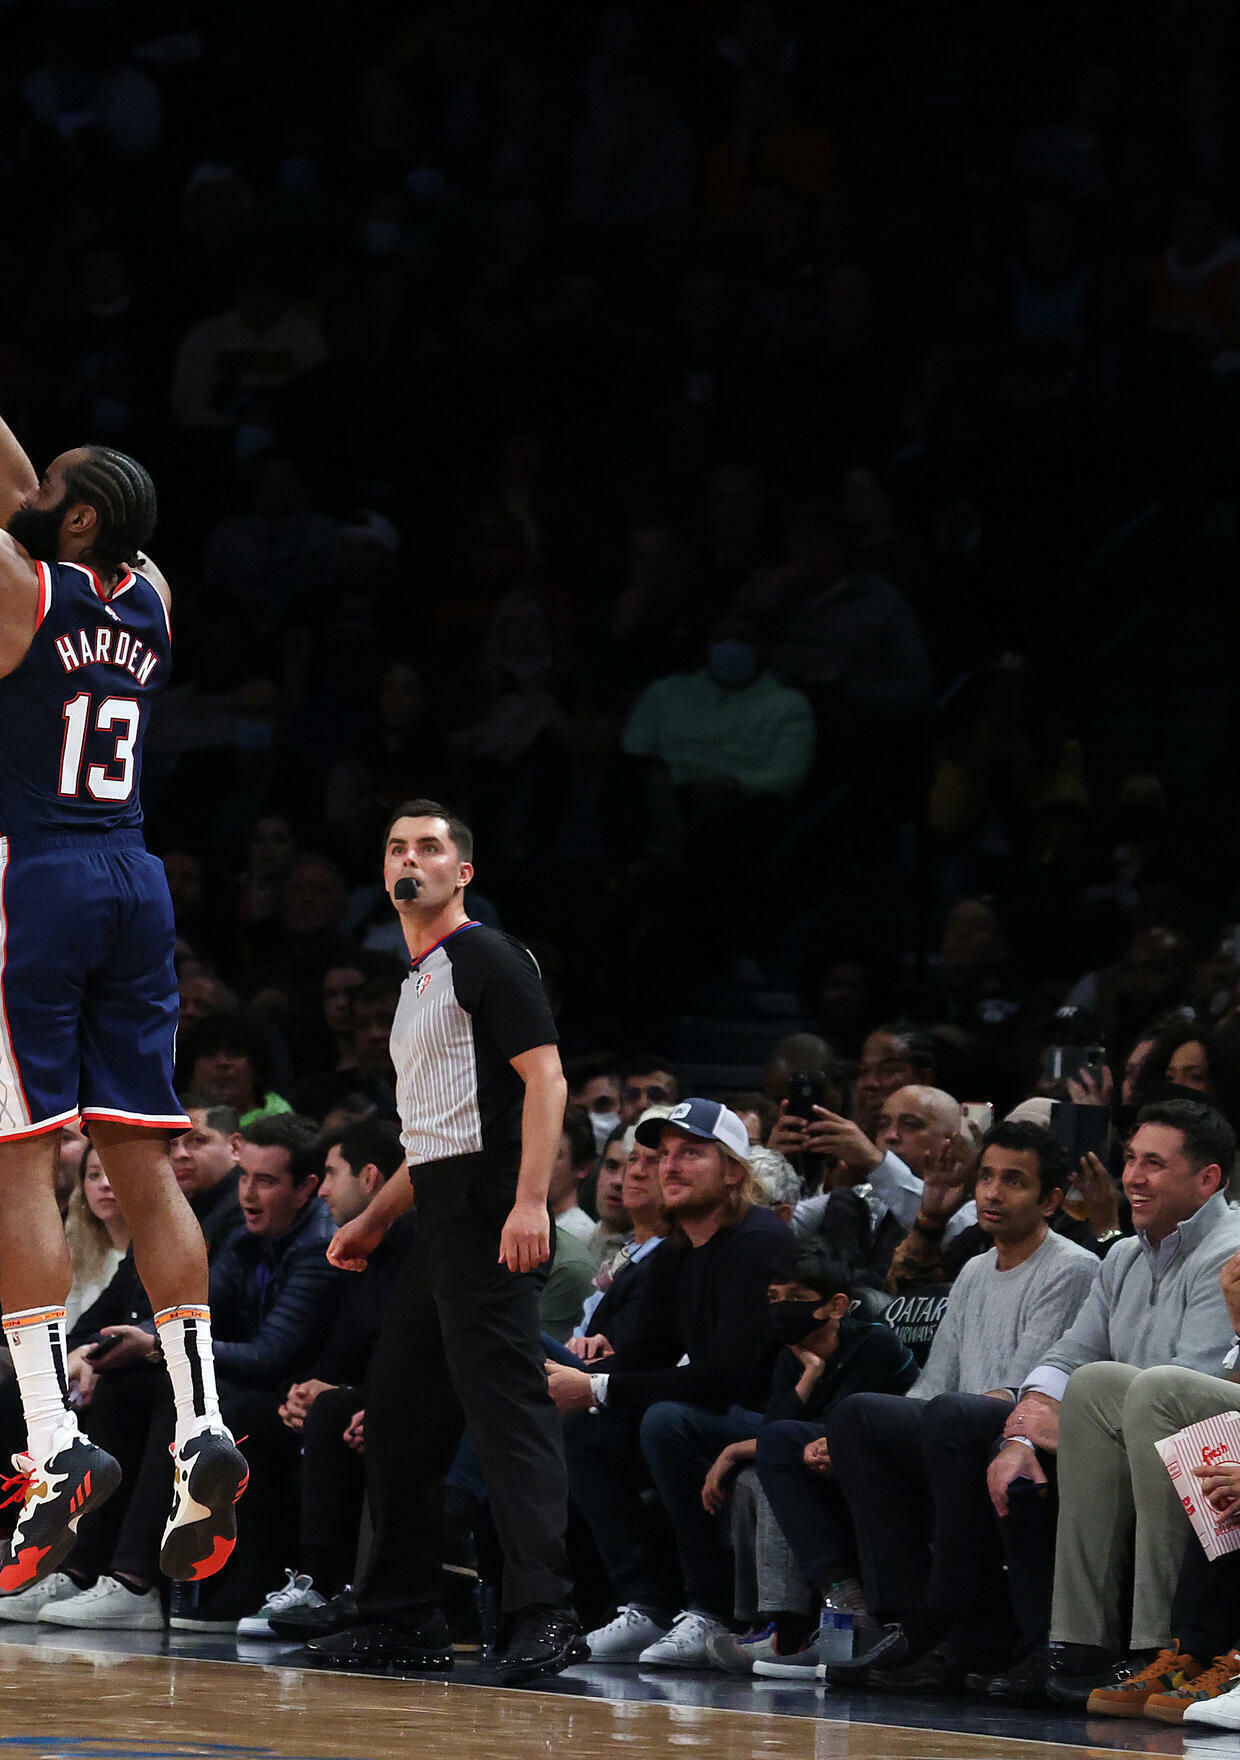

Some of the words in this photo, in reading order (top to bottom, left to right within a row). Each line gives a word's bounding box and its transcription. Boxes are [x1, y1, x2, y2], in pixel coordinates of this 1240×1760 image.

[55, 627, 159, 687] HARDEN
[58, 692, 140, 803] 13
[885, 1296, 948, 1328] QATAR
